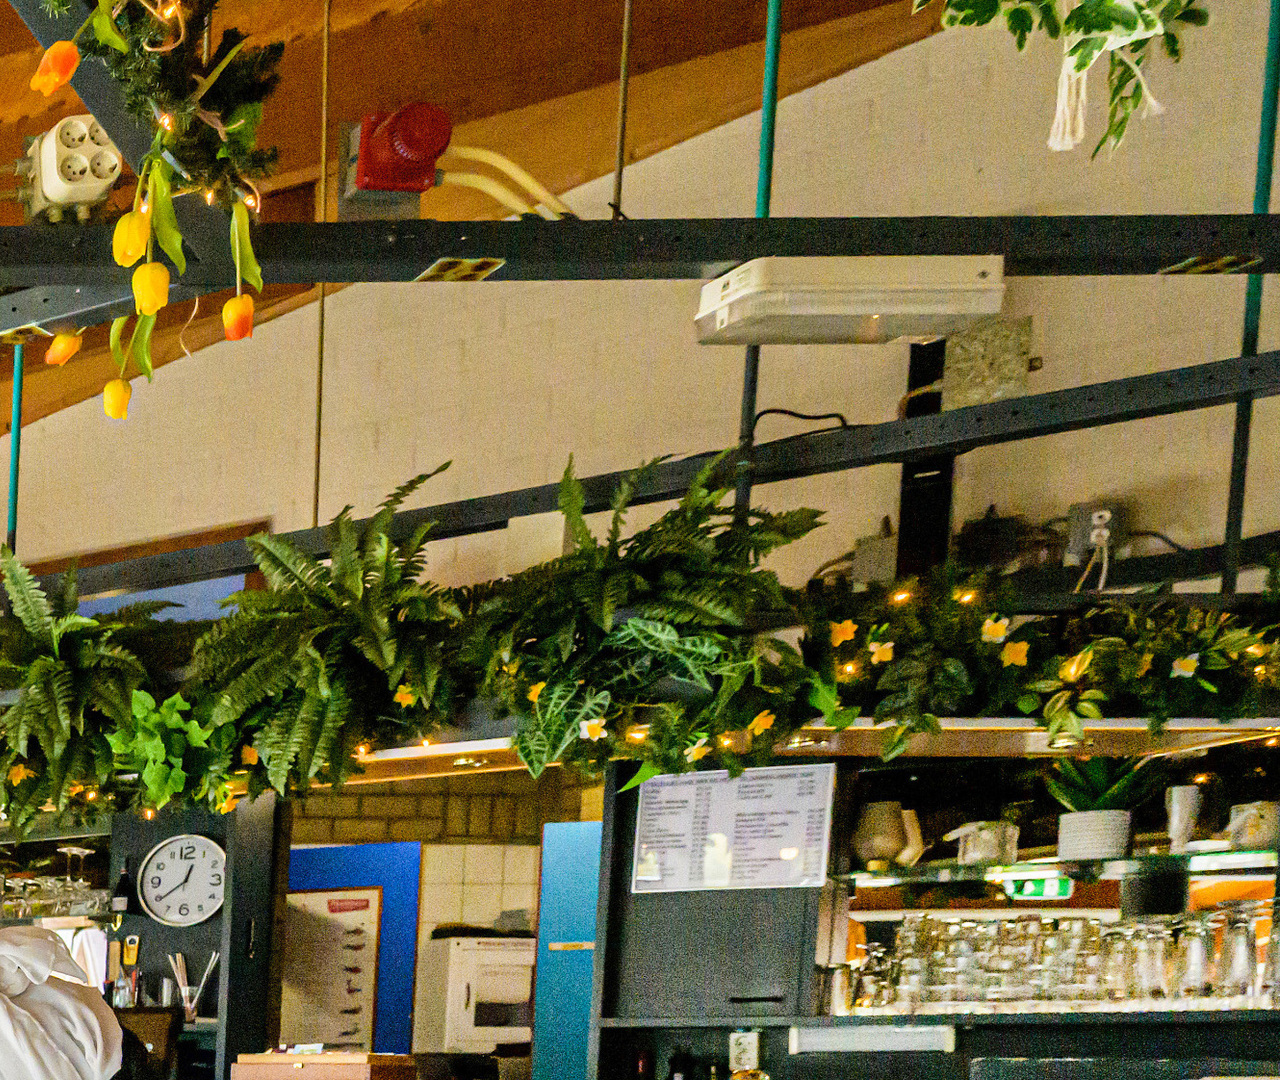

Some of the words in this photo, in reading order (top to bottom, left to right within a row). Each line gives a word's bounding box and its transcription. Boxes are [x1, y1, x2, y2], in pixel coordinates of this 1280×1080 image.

[180, 846, 196, 860] 12
[211, 860, 218, 868] 2
[151, 876, 161, 888] 9
[209, 873, 221, 886] 3
[178, 903, 189, 916] 6
